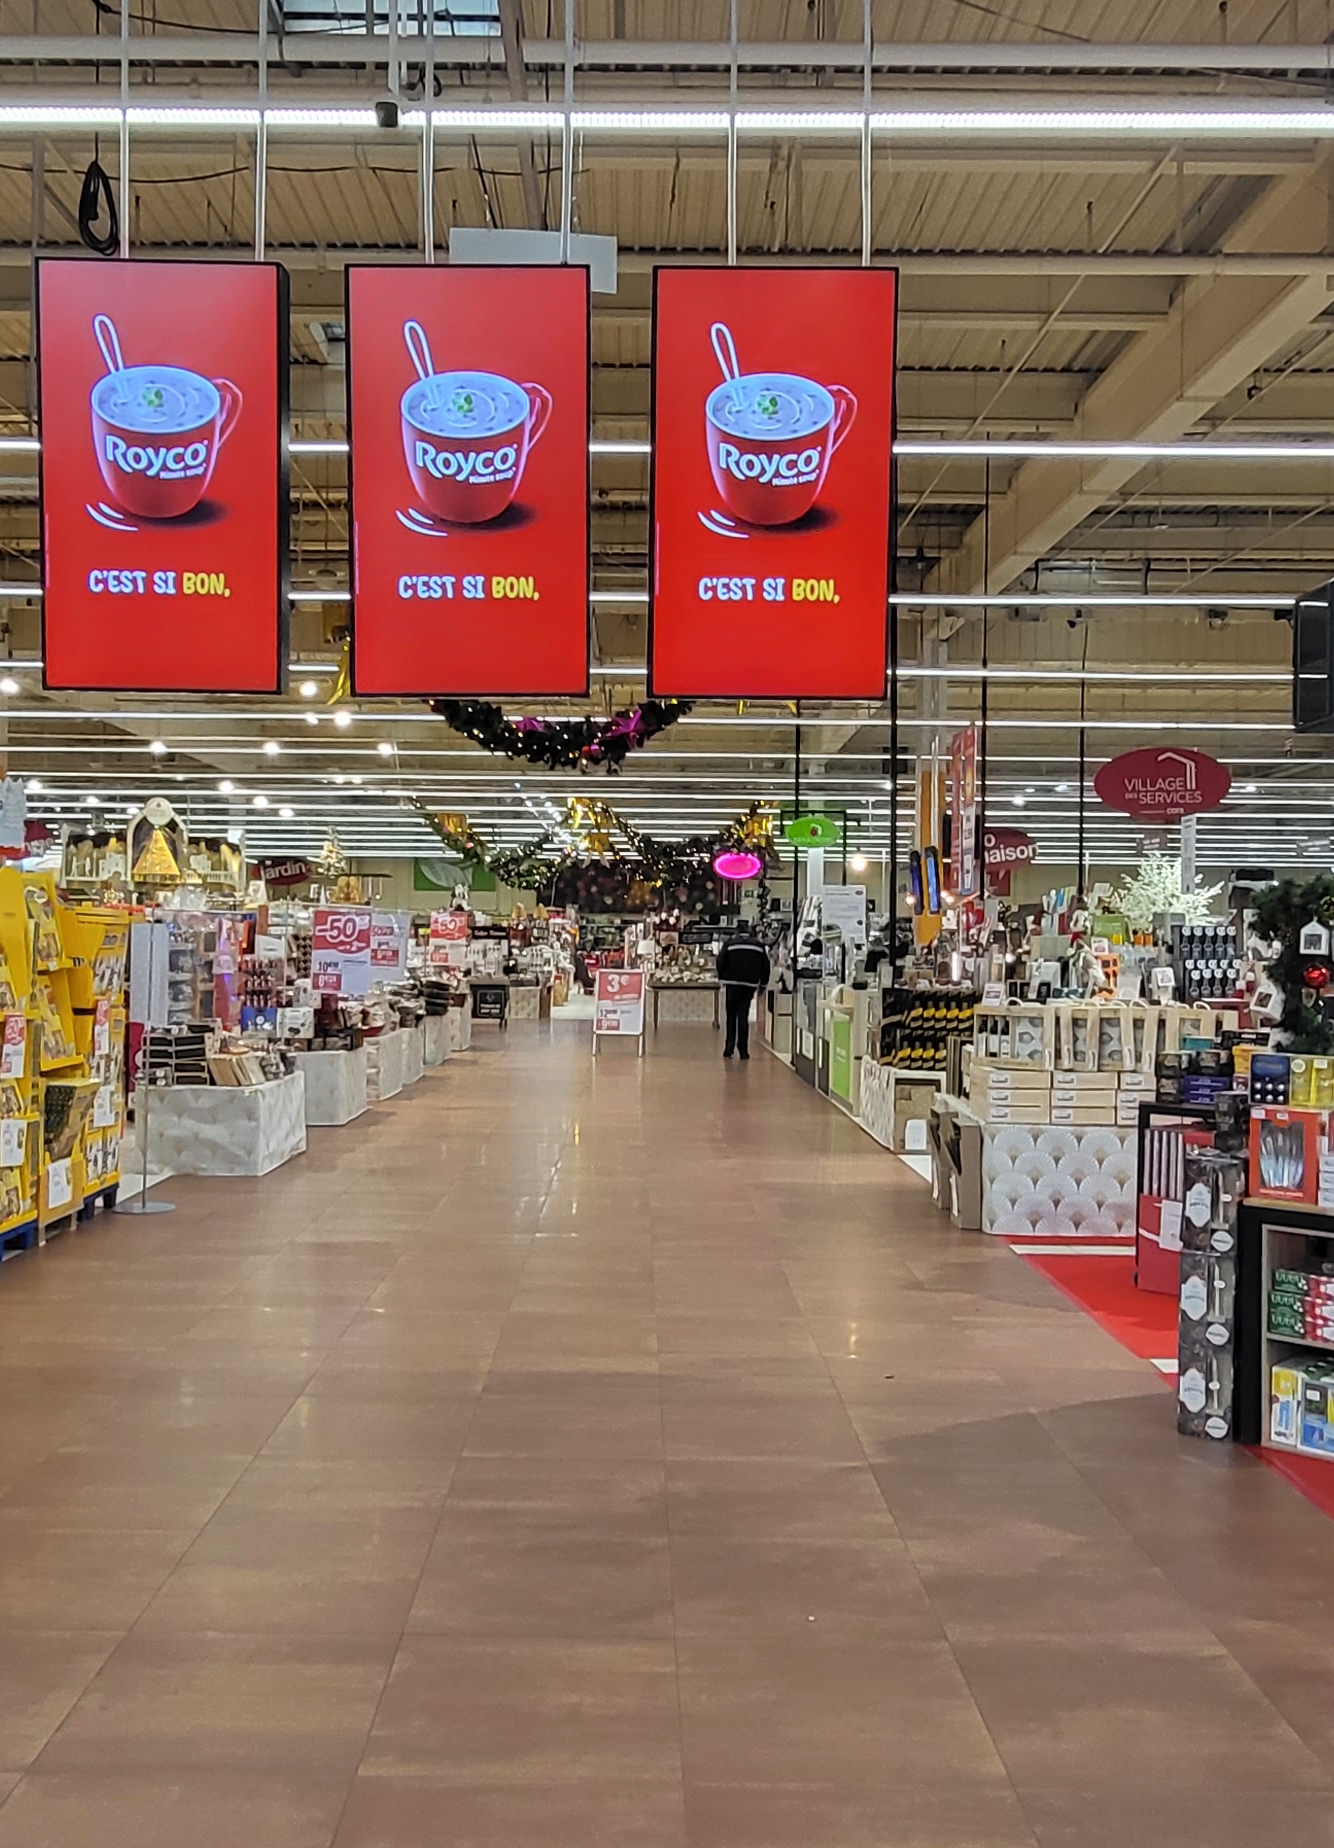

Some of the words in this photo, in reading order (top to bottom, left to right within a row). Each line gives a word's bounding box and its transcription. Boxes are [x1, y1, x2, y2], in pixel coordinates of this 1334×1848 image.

[89, 569, 147, 593] C'EST
[153, 571, 176, 594] SI
[182, 572, 231, 598] BON,
[398, 576, 456, 599] C'EST
[462, 576, 485, 599] SI
[492, 576, 540, 601] BON,
[698, 577, 756, 600] C'EST
[763, 577, 785, 601] SI
[792, 579, 840, 604] BON,
[1125, 778, 1185, 791] VILLAGE
[1139, 791, 1203, 804] SERVICES
[260, 860, 307, 881] jardin
